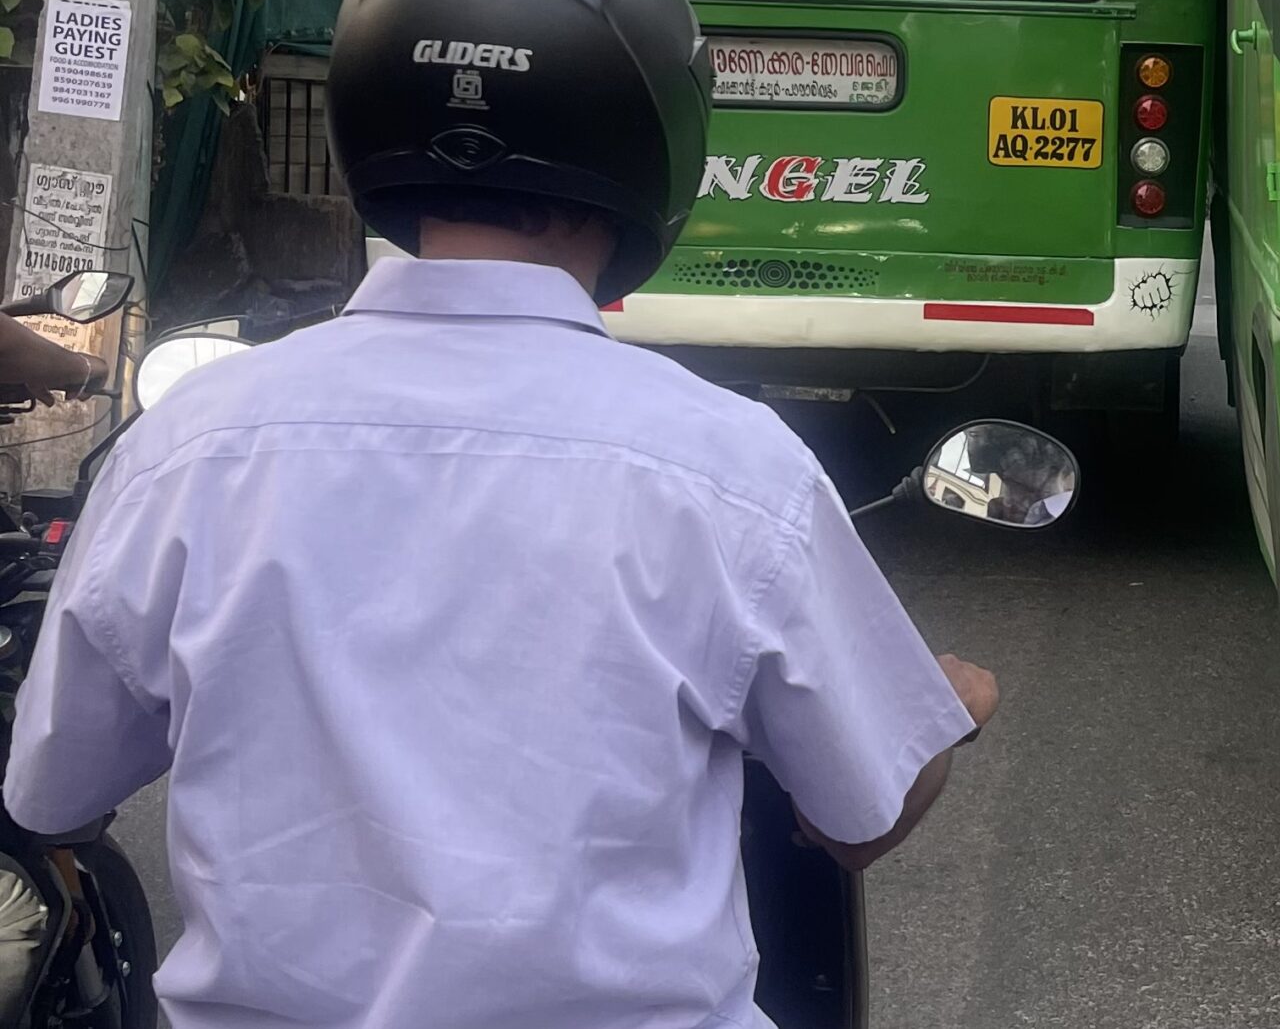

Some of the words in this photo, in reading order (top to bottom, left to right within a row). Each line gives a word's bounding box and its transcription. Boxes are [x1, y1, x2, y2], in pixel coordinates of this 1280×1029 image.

[55, 10, 122, 31] LADIES
[53, 25, 122, 46] PAYING
[50, 56, 67, 65] FOOD
[54, 42, 118, 61] GUEST
[413, 39, 534, 71] GLIDERS
[697, 155, 931, 204] NGEL
